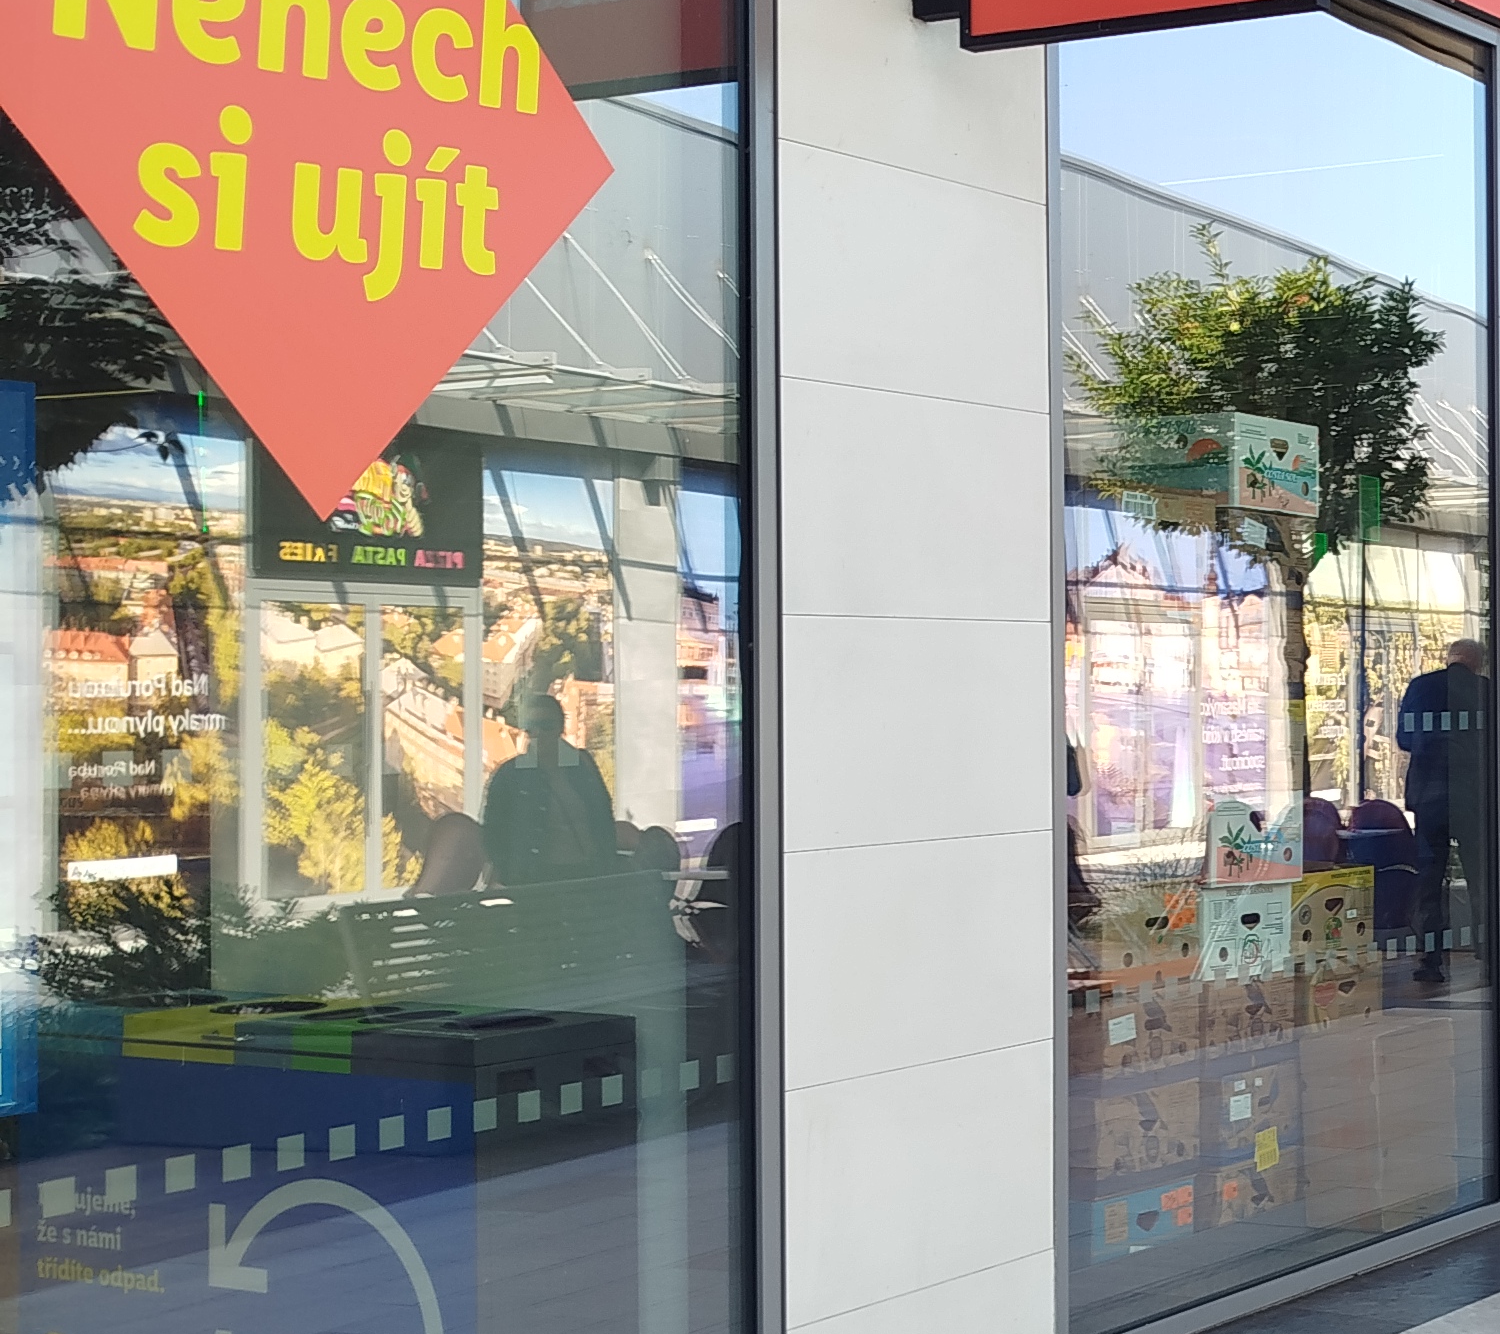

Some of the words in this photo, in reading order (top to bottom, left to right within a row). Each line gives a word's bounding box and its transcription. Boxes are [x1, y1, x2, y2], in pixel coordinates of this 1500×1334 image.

[132, 104, 254, 252] si
[291, 128, 500, 303] ujít
[36, 1220, 57, 1242] že
[62, 1231, 71, 1244] s
[76, 1225, 122, 1251] námi
[98, 1265, 165, 1294] odpad.
